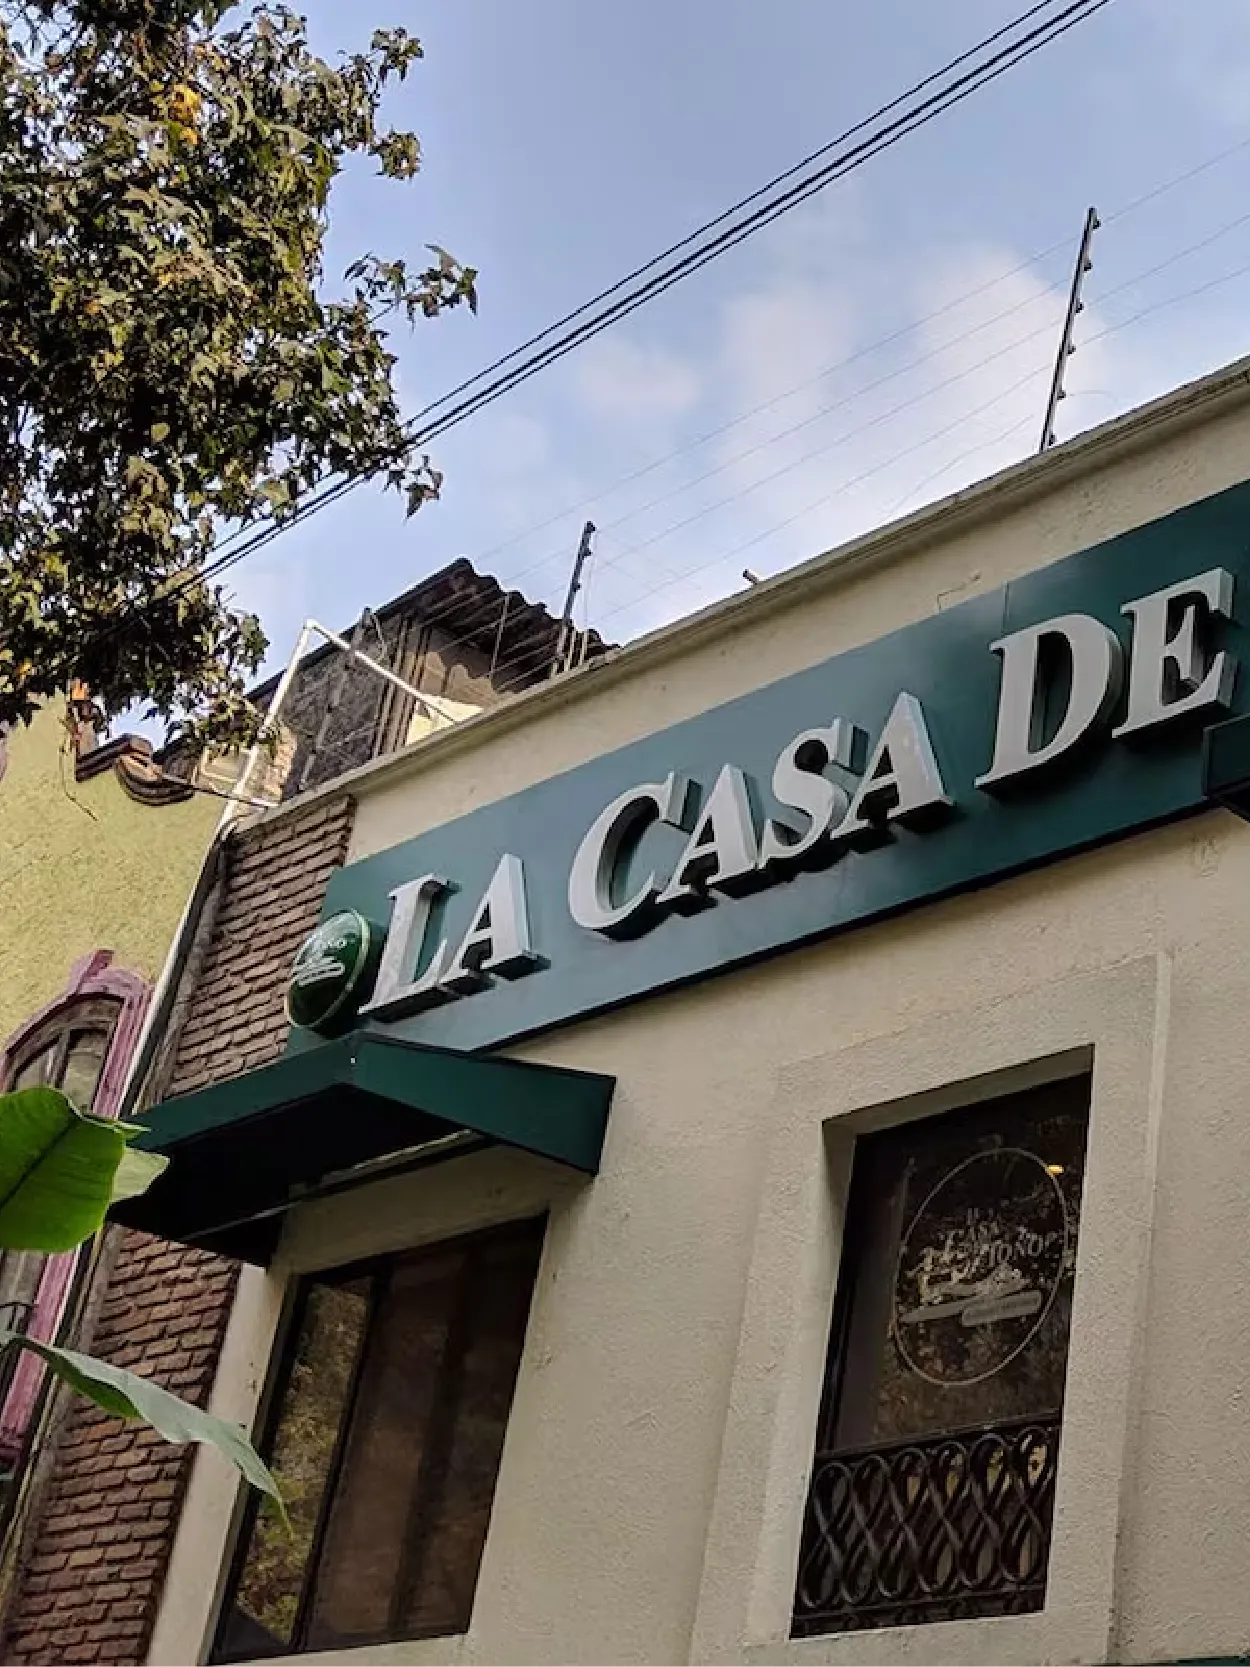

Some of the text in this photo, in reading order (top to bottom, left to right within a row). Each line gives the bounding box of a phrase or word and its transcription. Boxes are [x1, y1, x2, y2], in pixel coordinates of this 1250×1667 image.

[358, 853, 537, 1015] LA
[568, 691, 954, 930] CASA
[973, 567, 1235, 789] DE
